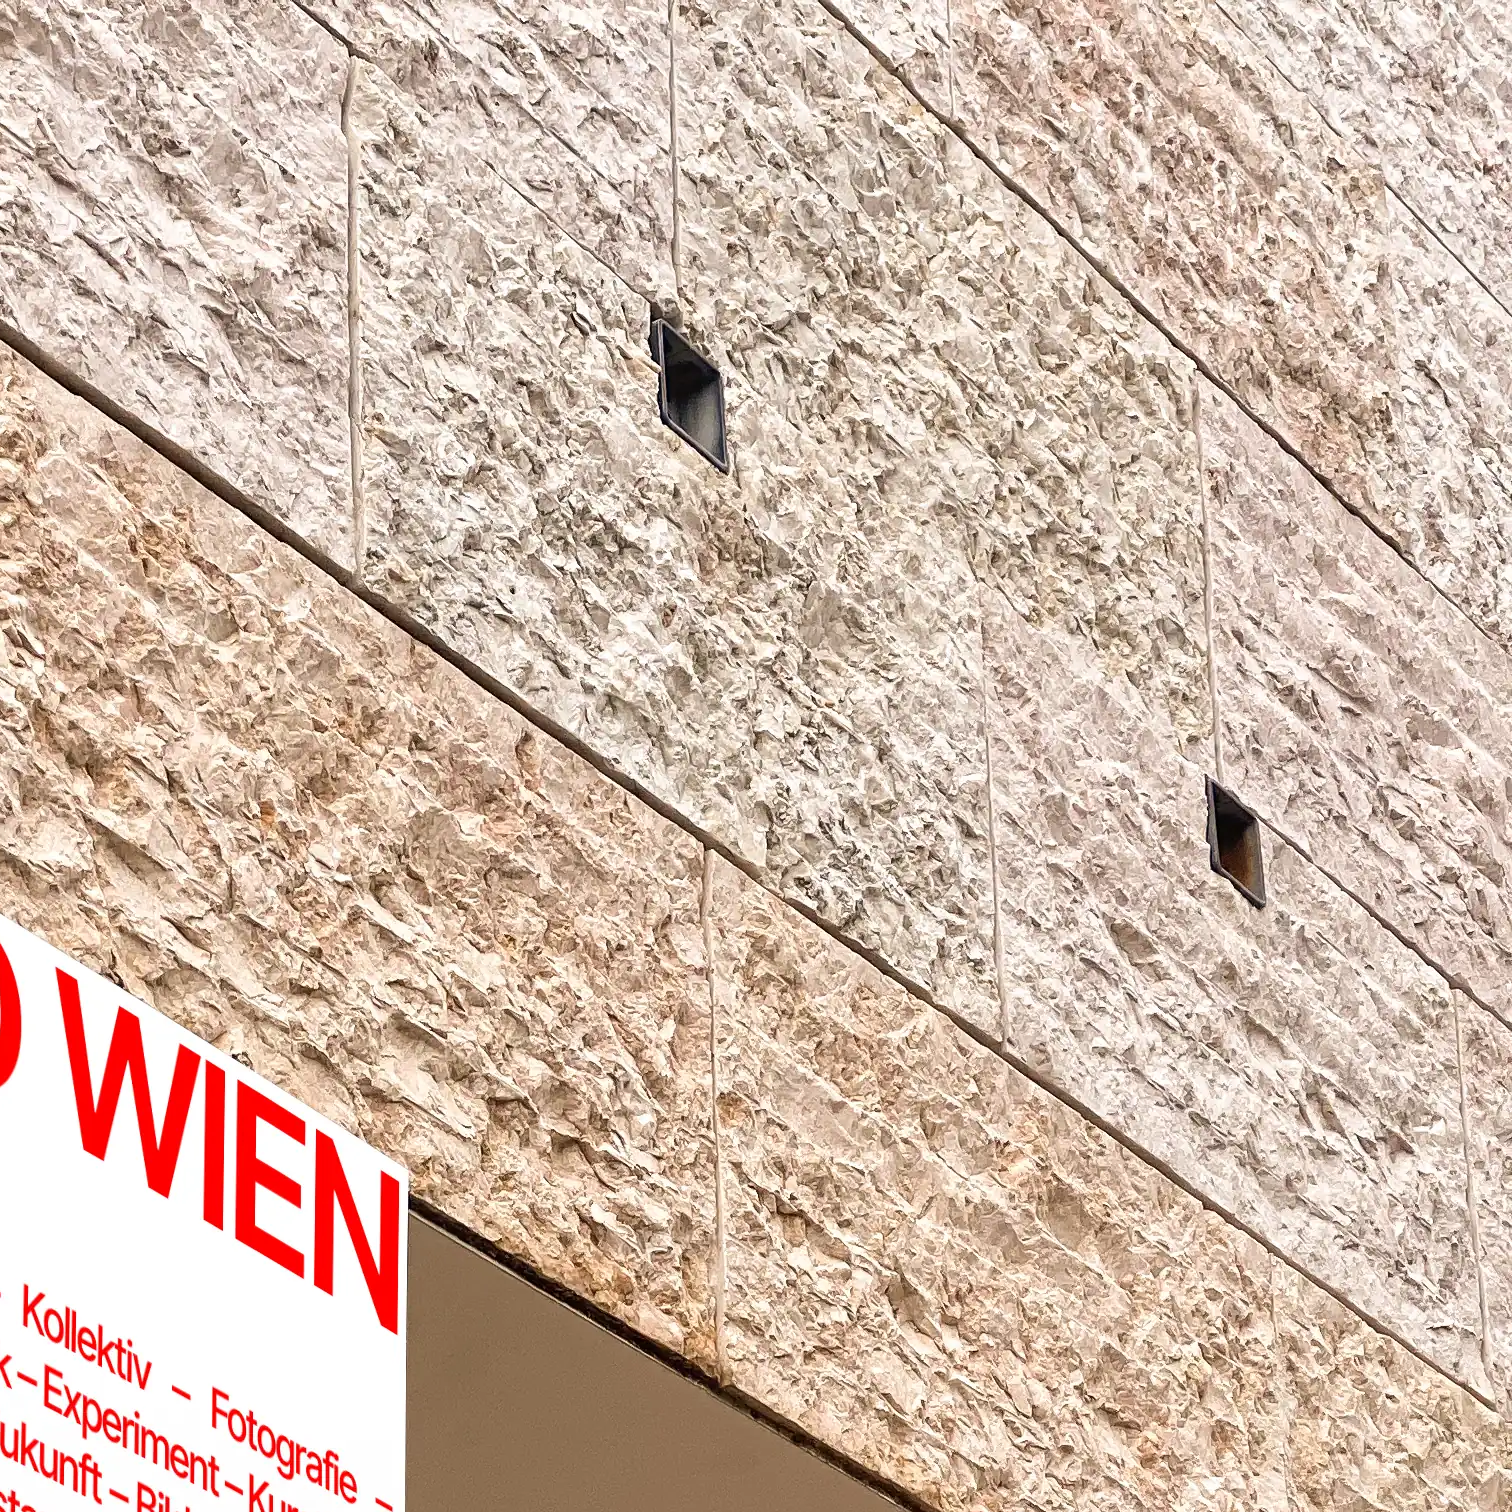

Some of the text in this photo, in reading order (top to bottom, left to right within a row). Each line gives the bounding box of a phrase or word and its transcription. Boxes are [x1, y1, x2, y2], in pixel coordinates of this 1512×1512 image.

[56, 968, 399, 1335] WIEN
[23, 1284, 152, 1390] Kollektiv
[212, 1387, 357, 1504] Fotografie
[44, 1364, 219, 1497] Experiment
